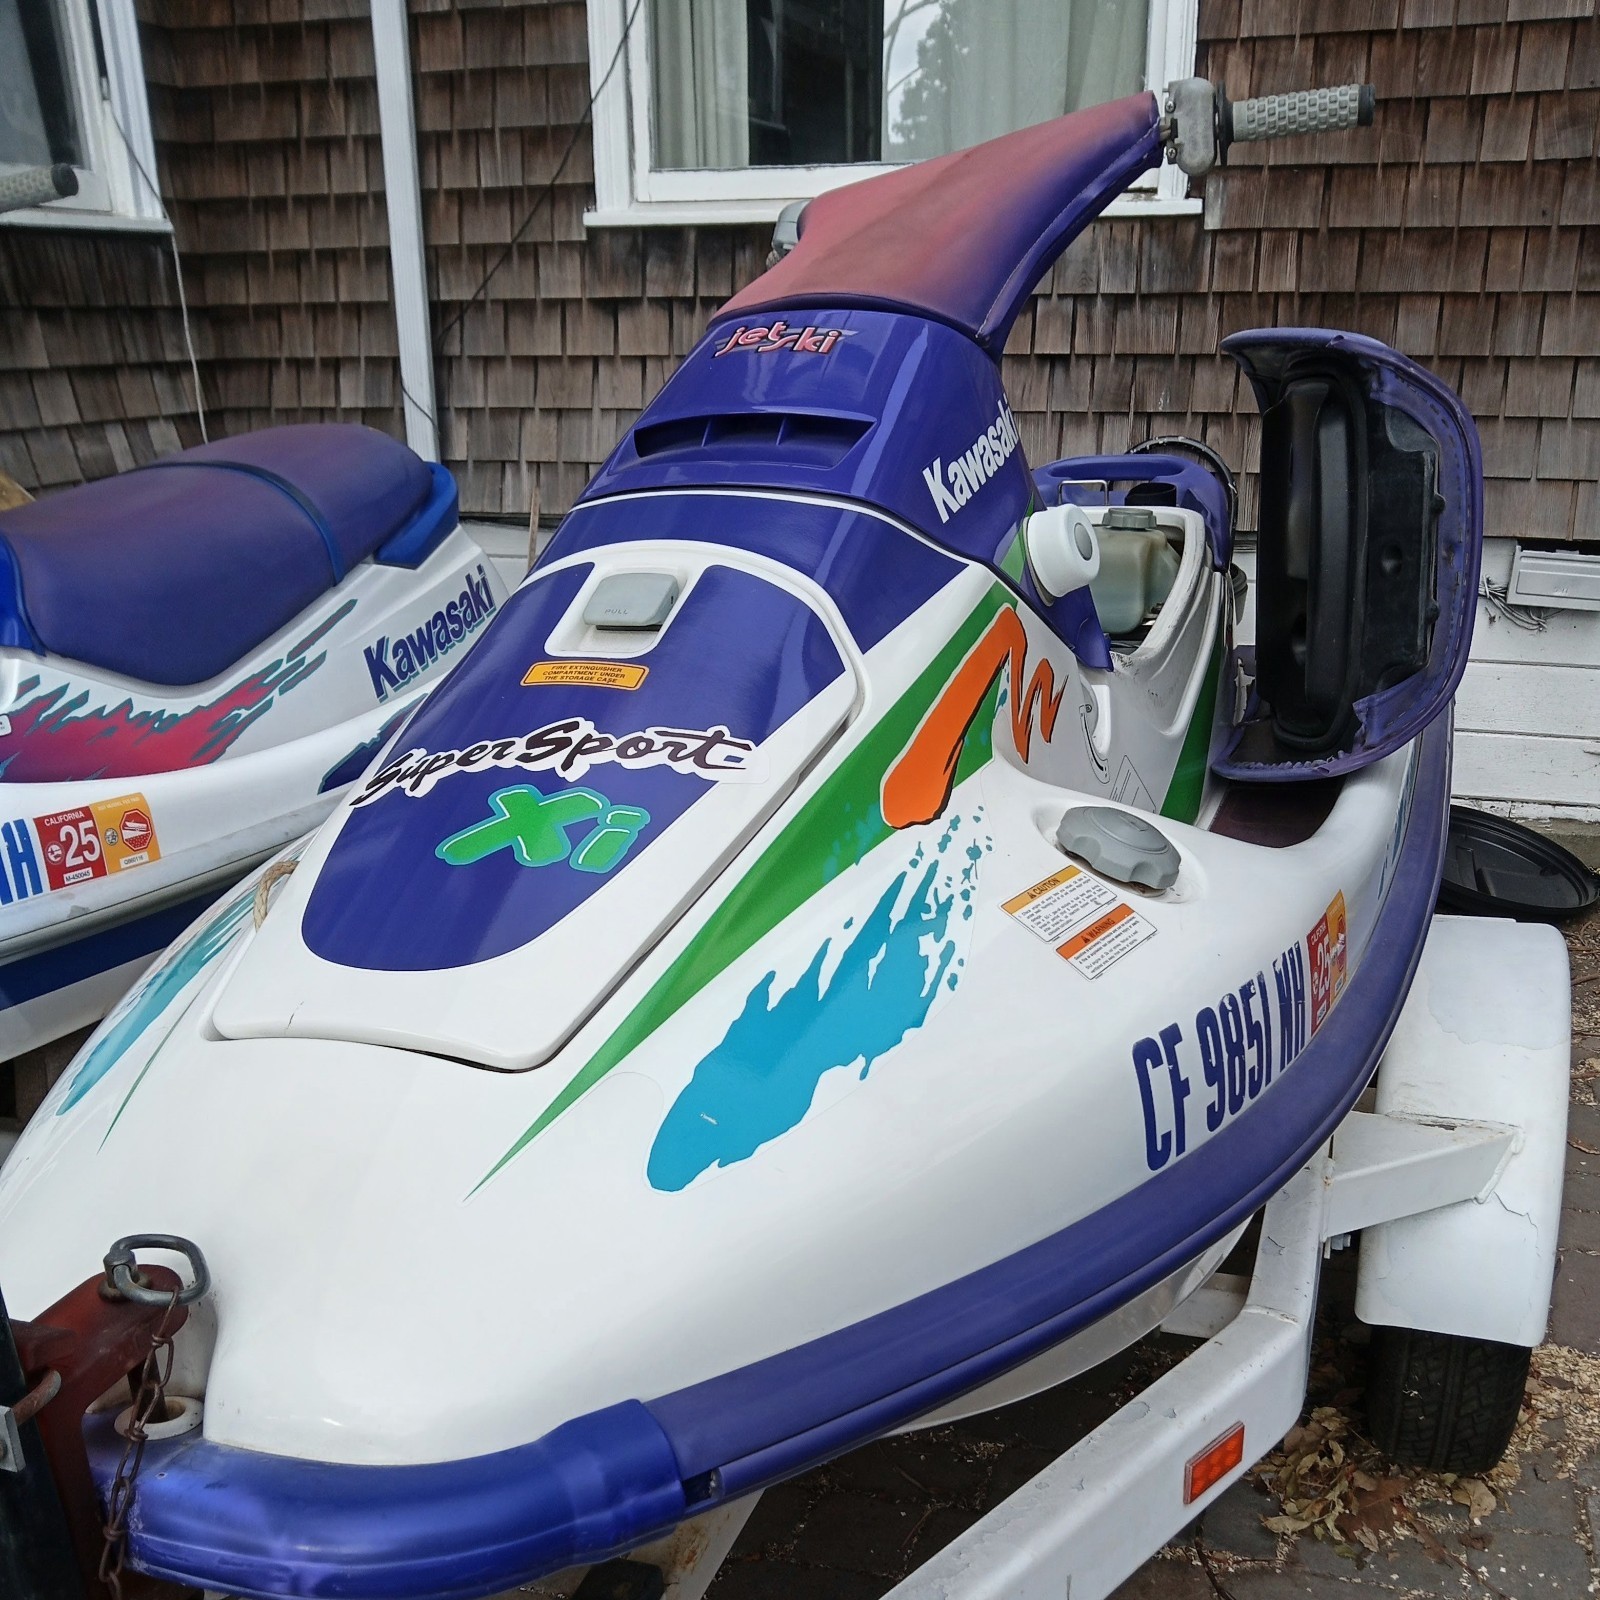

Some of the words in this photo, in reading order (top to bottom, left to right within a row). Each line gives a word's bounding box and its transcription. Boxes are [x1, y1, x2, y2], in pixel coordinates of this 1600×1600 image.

[922, 393, 1020, 524] Kawasaki
[363, 564, 496, 702] Kawasaki
[569, 665, 623, 673] EXTINGUISHER
[596, 676, 618, 684] CASE
[44, 811, 85, 827] CALIFORNIA
[59, 820, 101, 868] 25
[1033, 877, 1061, 896] CAUTION
[1085, 918, 1116, 940] WARNING
[1132, 1022, 1191, 1171] CF
[1196, 970, 1272, 1132] 9851
